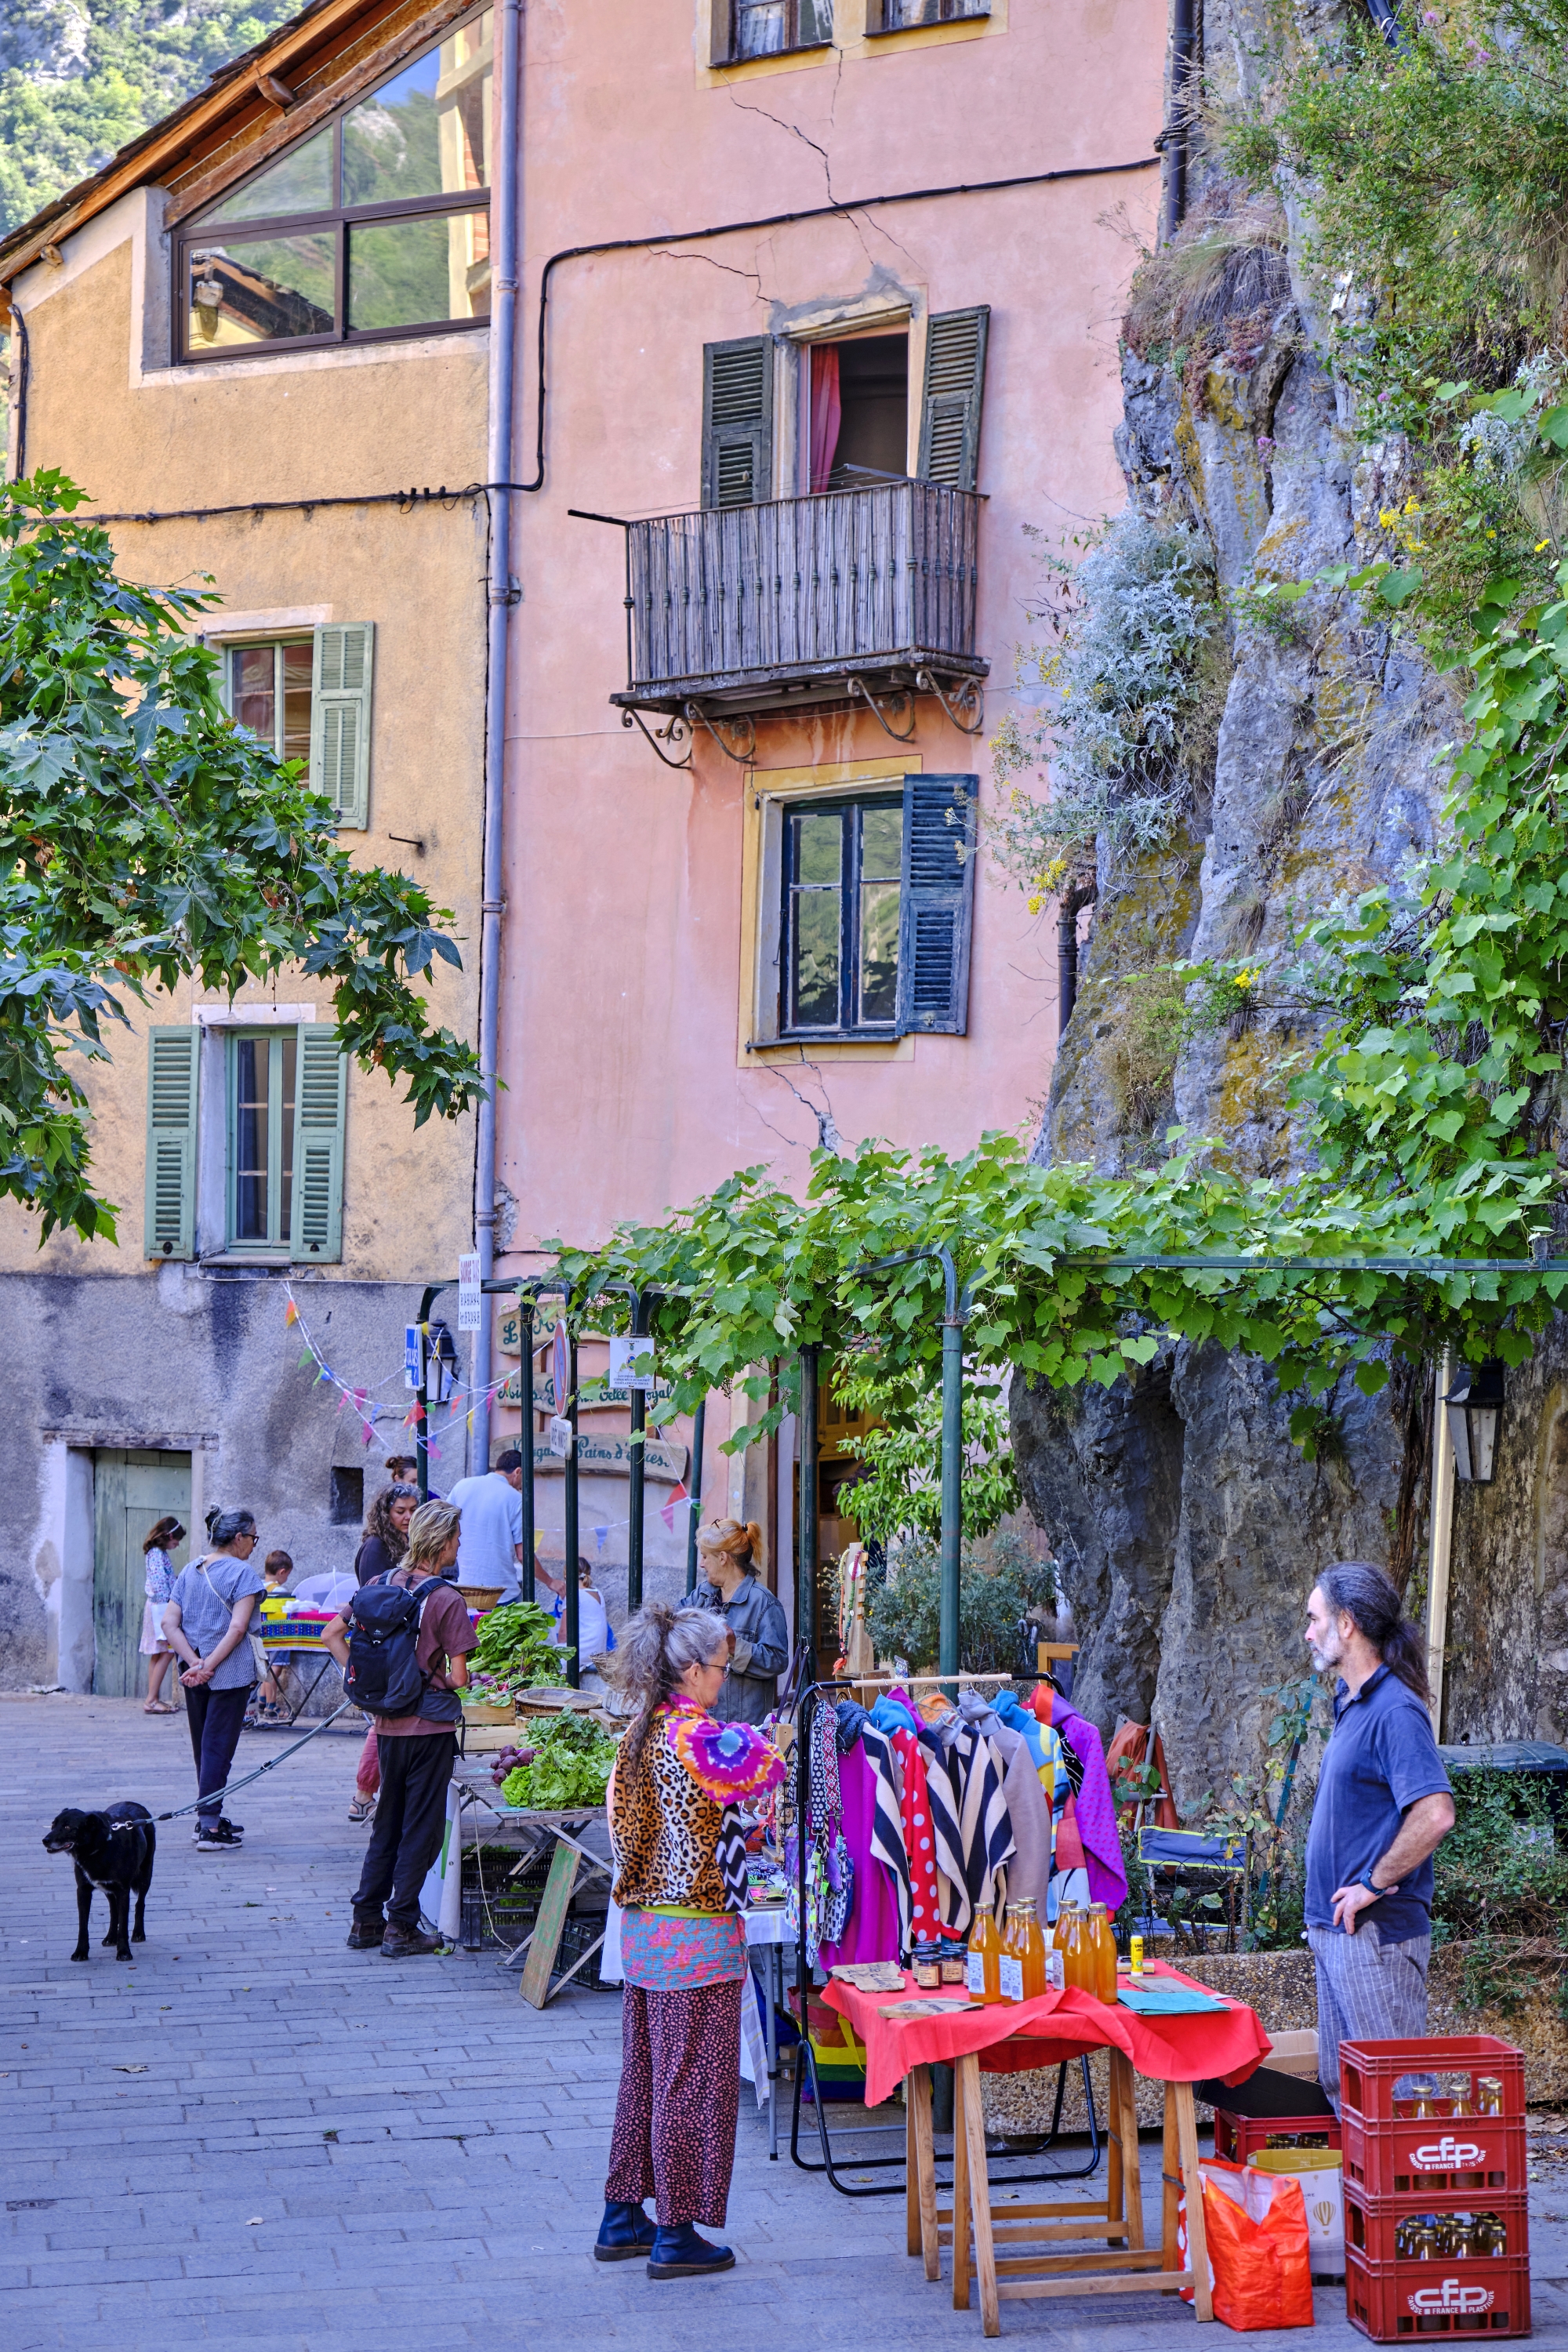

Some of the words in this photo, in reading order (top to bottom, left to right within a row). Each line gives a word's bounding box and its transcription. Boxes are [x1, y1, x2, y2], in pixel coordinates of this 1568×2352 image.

[577, 1436, 612, 1459] Pains
[1409, 2153, 1423, 2170] CAISSE
[1417, 2136, 1479, 2169] cfp
[1407, 2295, 1422, 2315] CAISSE
[1468, 2290, 1494, 2314] PLASTIQUE
[1414, 2278, 1487, 2313] cfp
